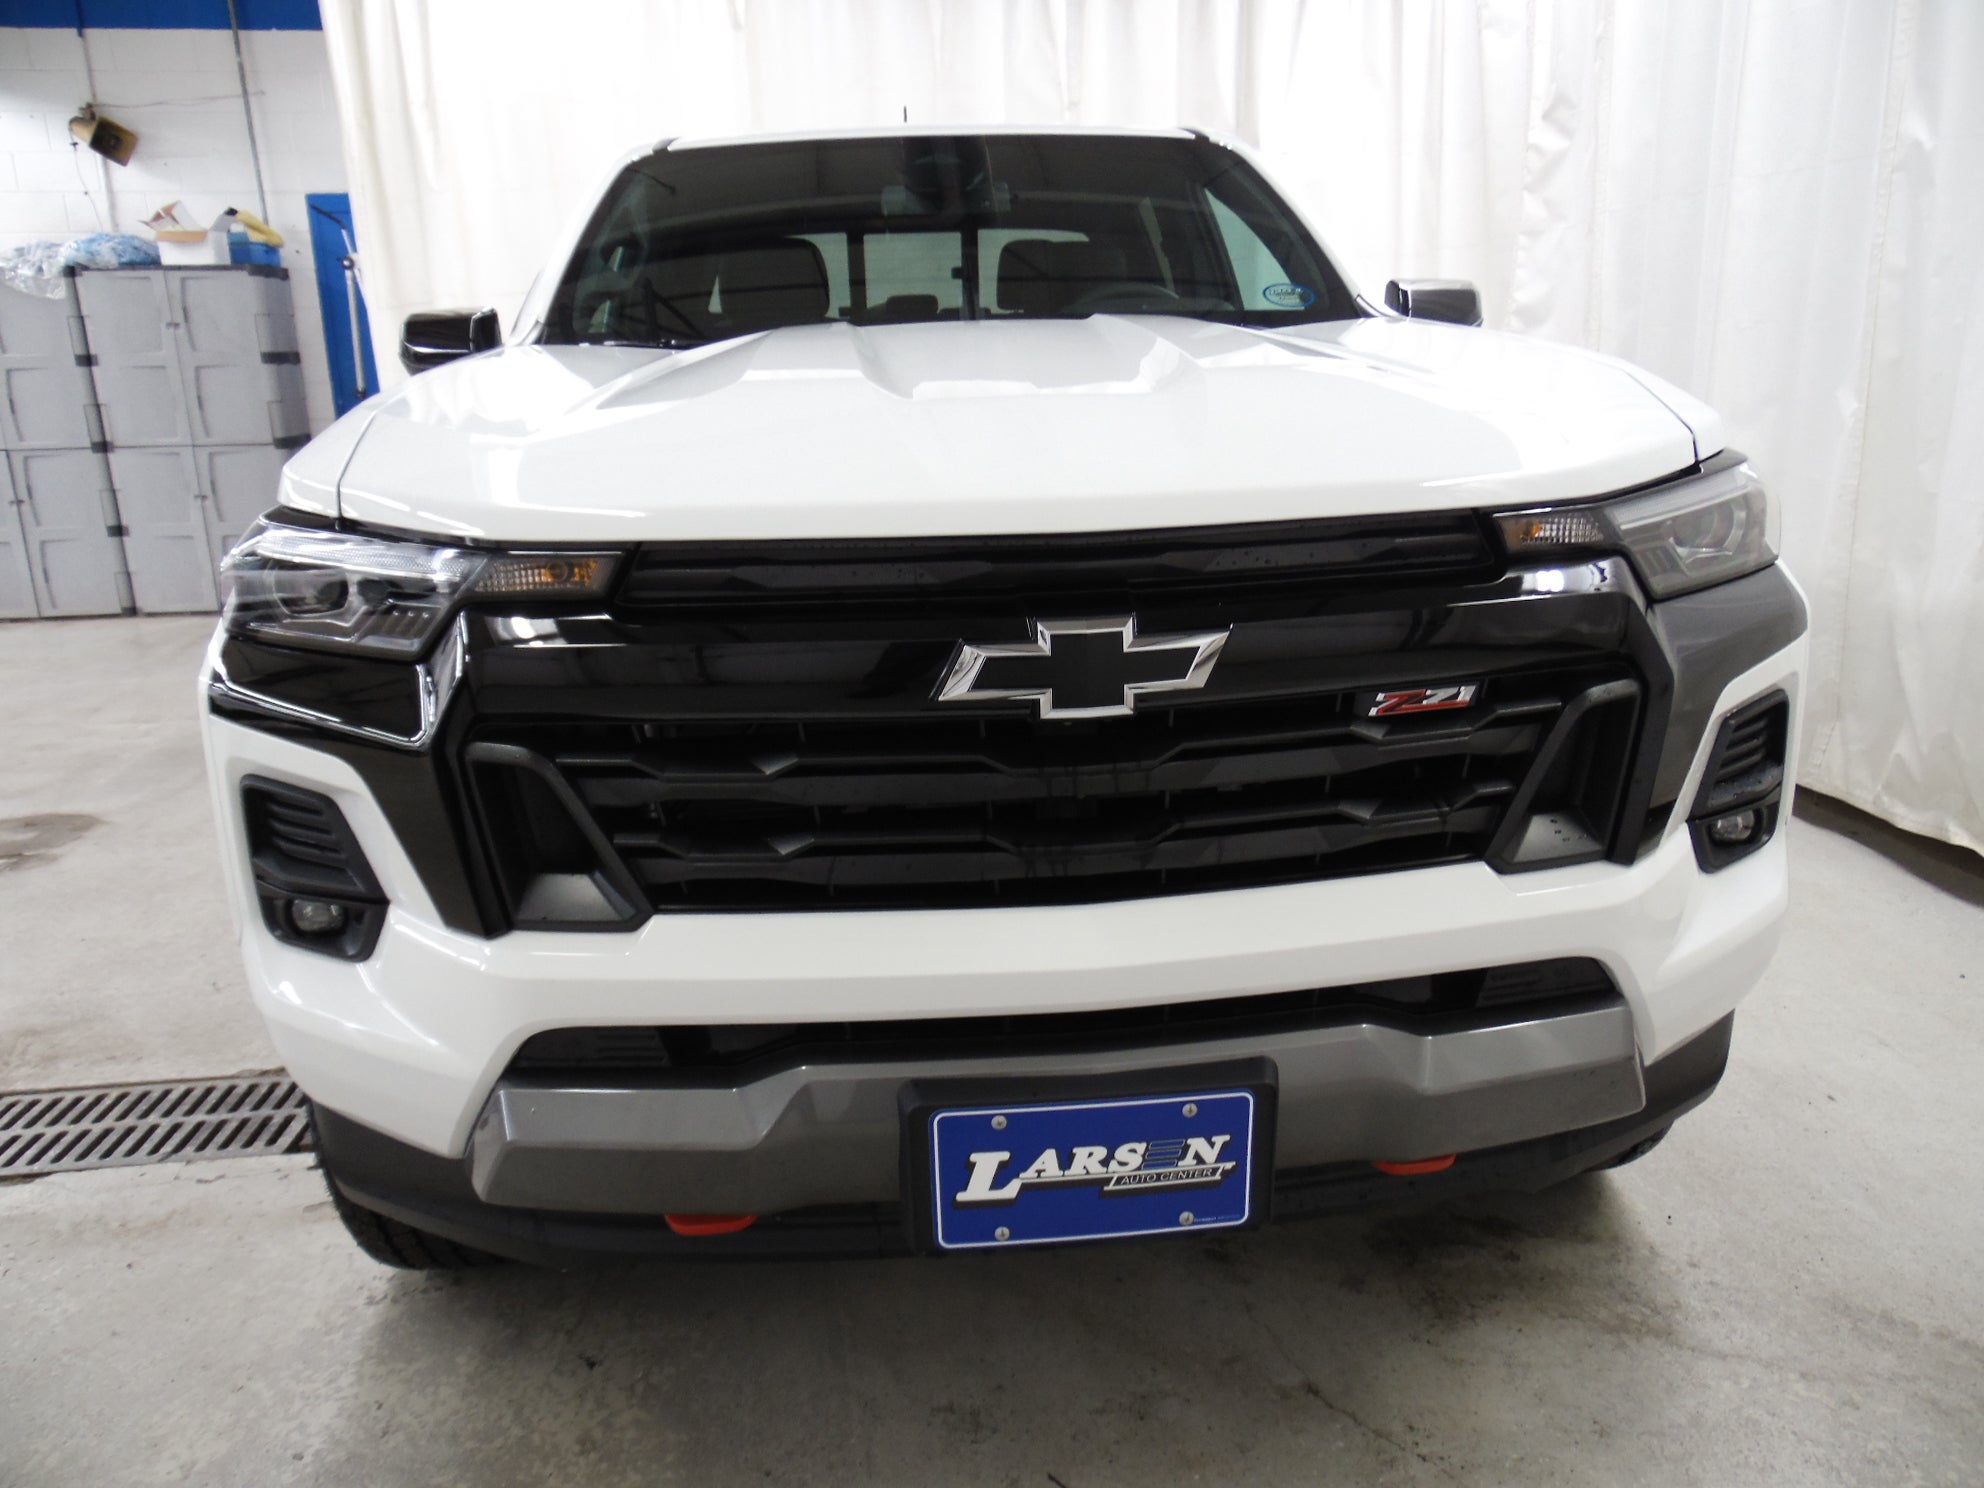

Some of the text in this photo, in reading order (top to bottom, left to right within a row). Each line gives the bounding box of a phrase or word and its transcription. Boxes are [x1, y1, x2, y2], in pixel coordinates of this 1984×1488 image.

[1368, 686, 1476, 717] Z71
[956, 1135, 1231, 1201] LARSEN
[1121, 1168, 1213, 1186] AUTO CENTER
